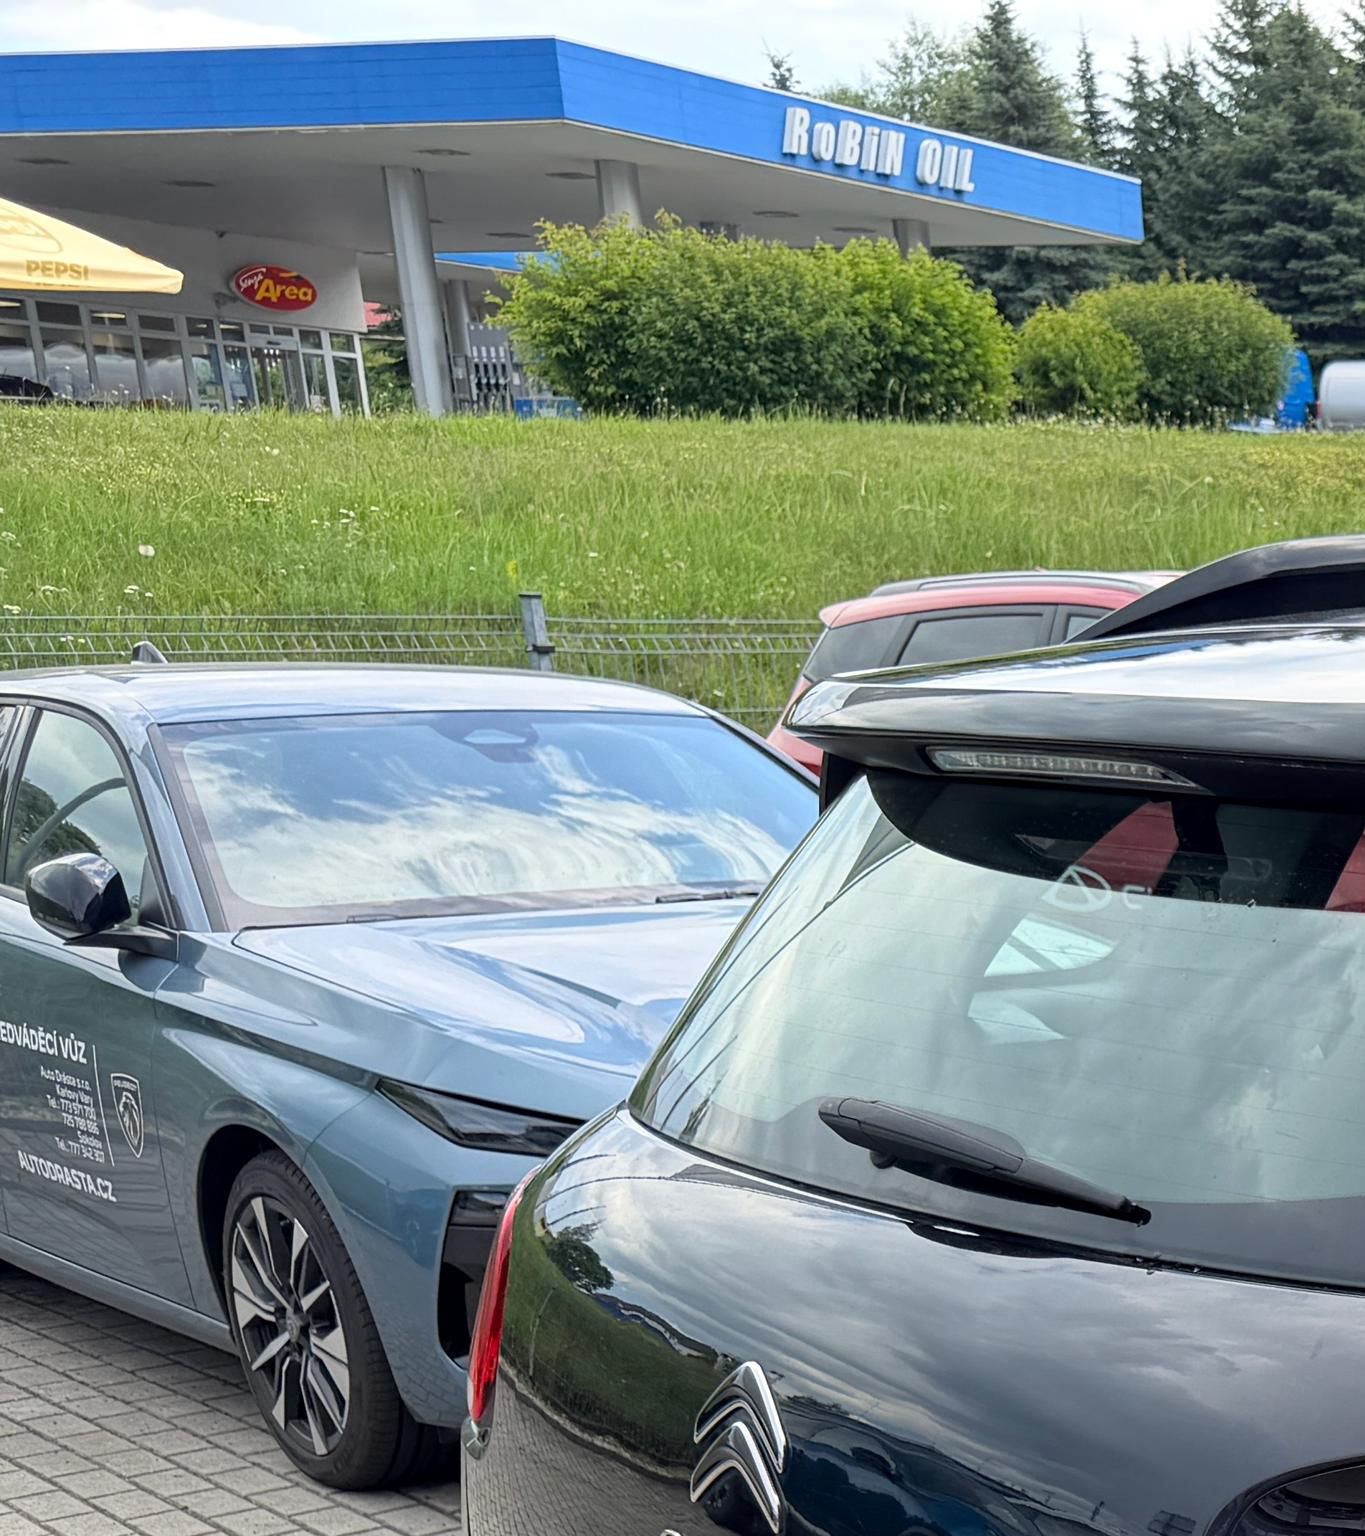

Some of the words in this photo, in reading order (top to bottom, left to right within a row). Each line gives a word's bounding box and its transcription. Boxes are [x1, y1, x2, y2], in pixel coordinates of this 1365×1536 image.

[915, 139, 975, 193] OIL
[26, 259, 89, 281] PEPSI
[255, 278, 312, 303] Area
[0, 1020, 58, 1056] EDVÁDĚCÍ
[59, 1033, 87, 1064] VŮZ
[18, 1150, 117, 1202] AUTODRASTA.CZ
